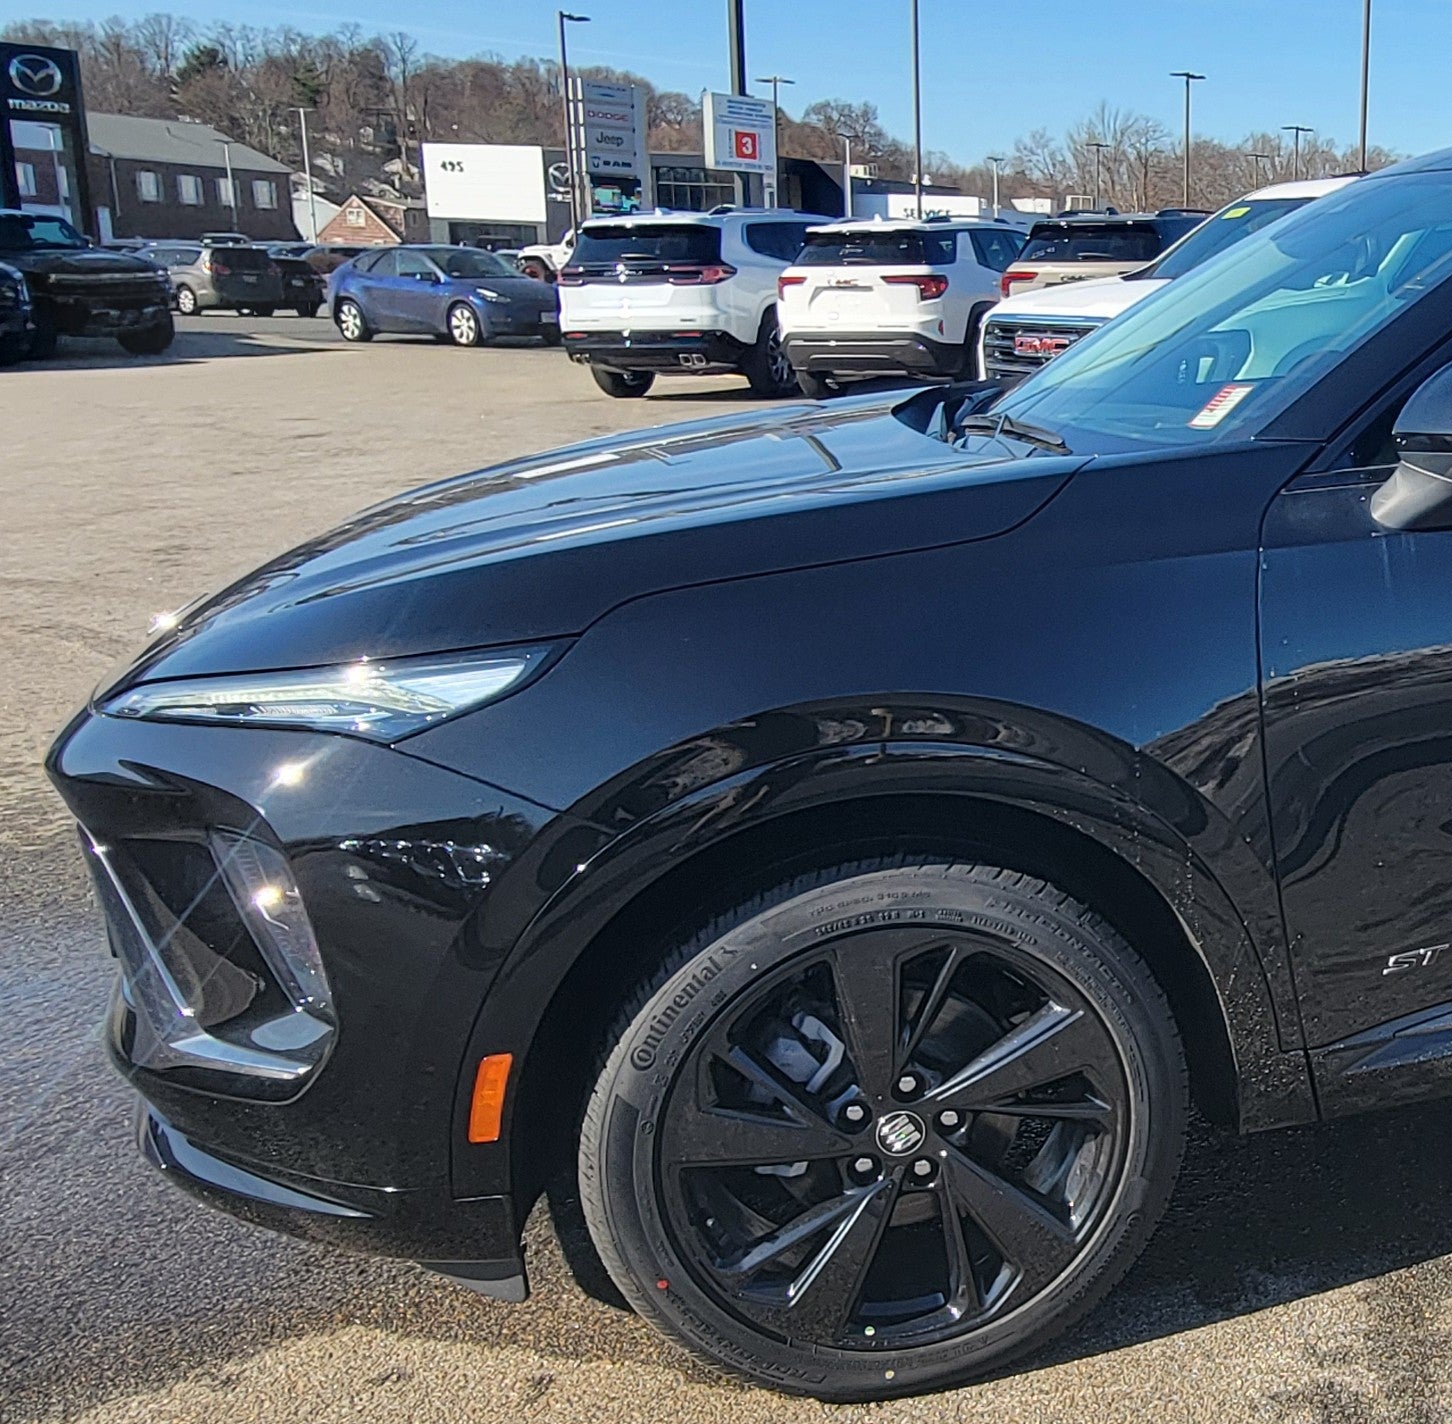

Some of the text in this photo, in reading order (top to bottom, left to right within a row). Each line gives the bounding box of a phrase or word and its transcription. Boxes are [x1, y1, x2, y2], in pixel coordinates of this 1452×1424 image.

[7, 98, 70, 114] mazda
[587, 110, 629, 122] DODGE
[596, 131, 624, 147] Jeep
[741, 136, 754, 155] 3
[440, 160, 465, 173] 495
[603, 160, 632, 169] RAM
[903, 207, 952, 220] SEVICE
[1015, 337, 1070, 353] GMC
[1382, 942, 1450, 976] ST
[630, 955, 724, 1073] Continental
